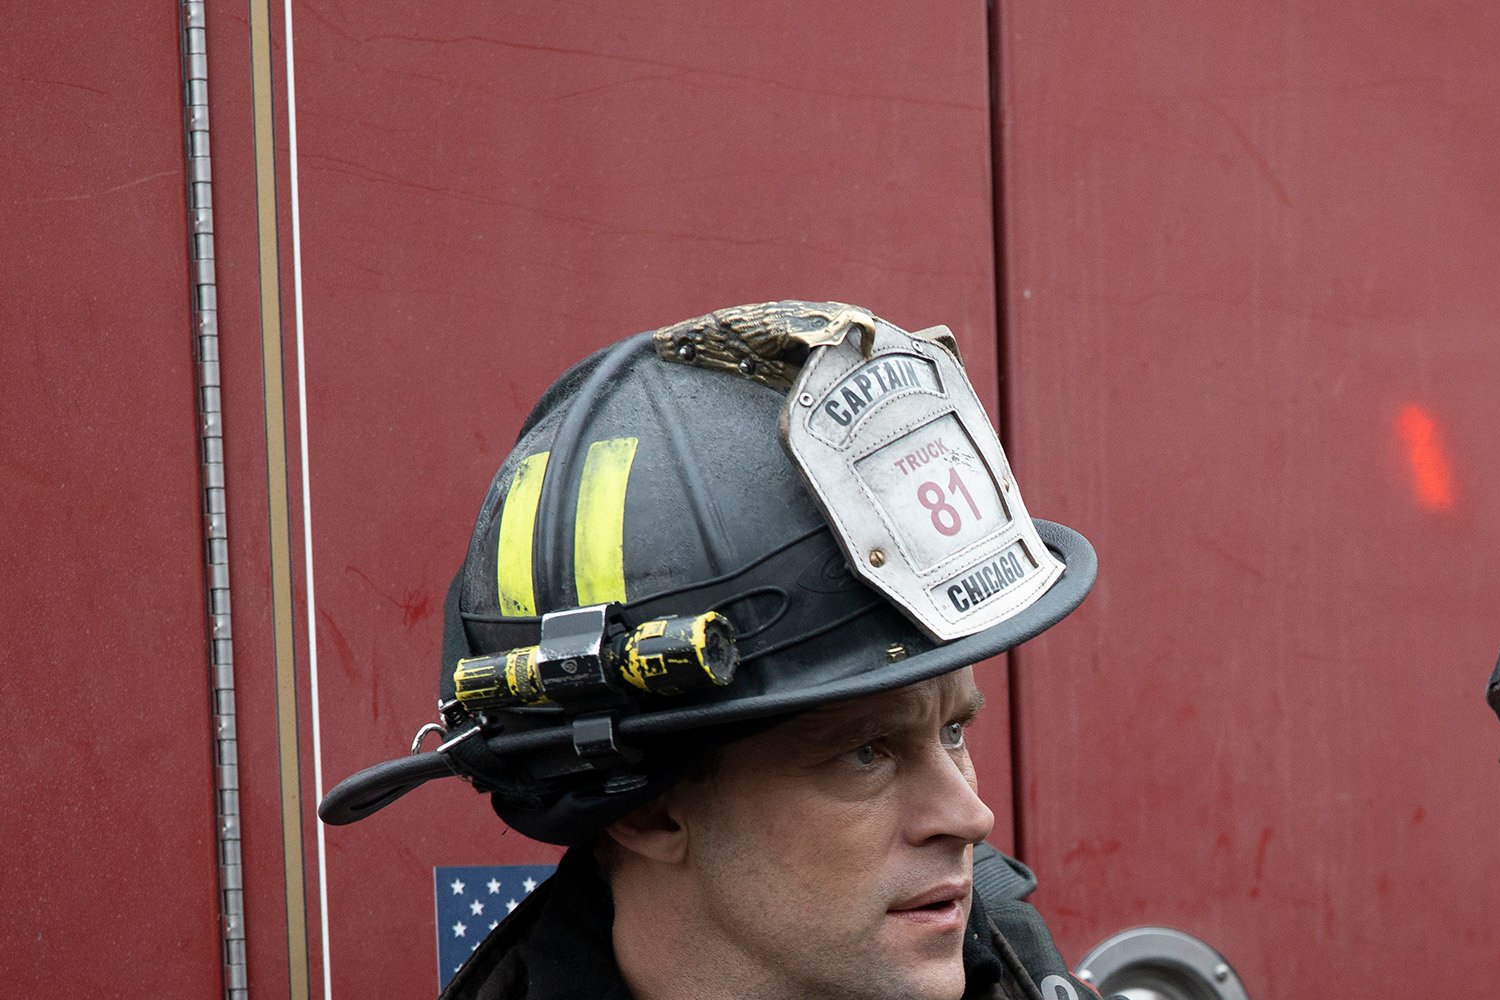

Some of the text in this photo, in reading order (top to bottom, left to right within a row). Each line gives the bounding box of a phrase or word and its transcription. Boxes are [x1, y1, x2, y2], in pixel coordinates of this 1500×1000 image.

[824, 355, 920, 427] CAPTAIN
[893, 437, 950, 477] TRUCK
[916, 466, 983, 537] 81
[946, 550, 1026, 613] CHICAGO
